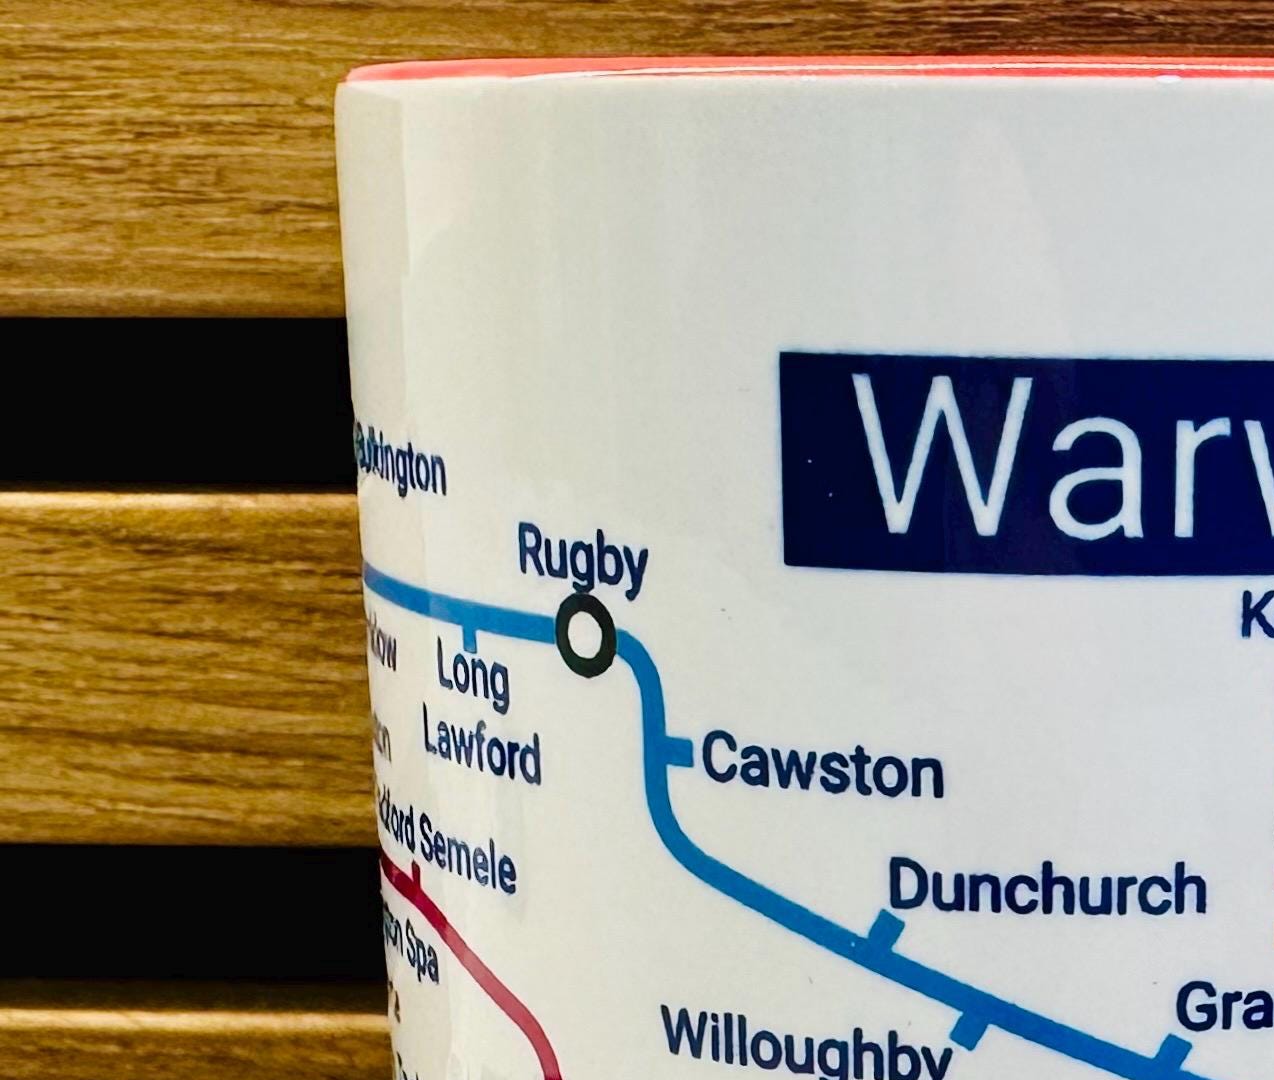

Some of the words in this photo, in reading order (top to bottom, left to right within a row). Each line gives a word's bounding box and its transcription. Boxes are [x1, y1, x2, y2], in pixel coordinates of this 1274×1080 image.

[518, 521, 649, 601] Rugby
[437, 636, 510, 716] Long
[422, 702, 542, 786] Lawford
[702, 729, 945, 799] Cawston
[419, 812, 517, 895] Semele
[889, 856, 1207, 916] Dunchurch
[405, 918, 440, 985] Spa
